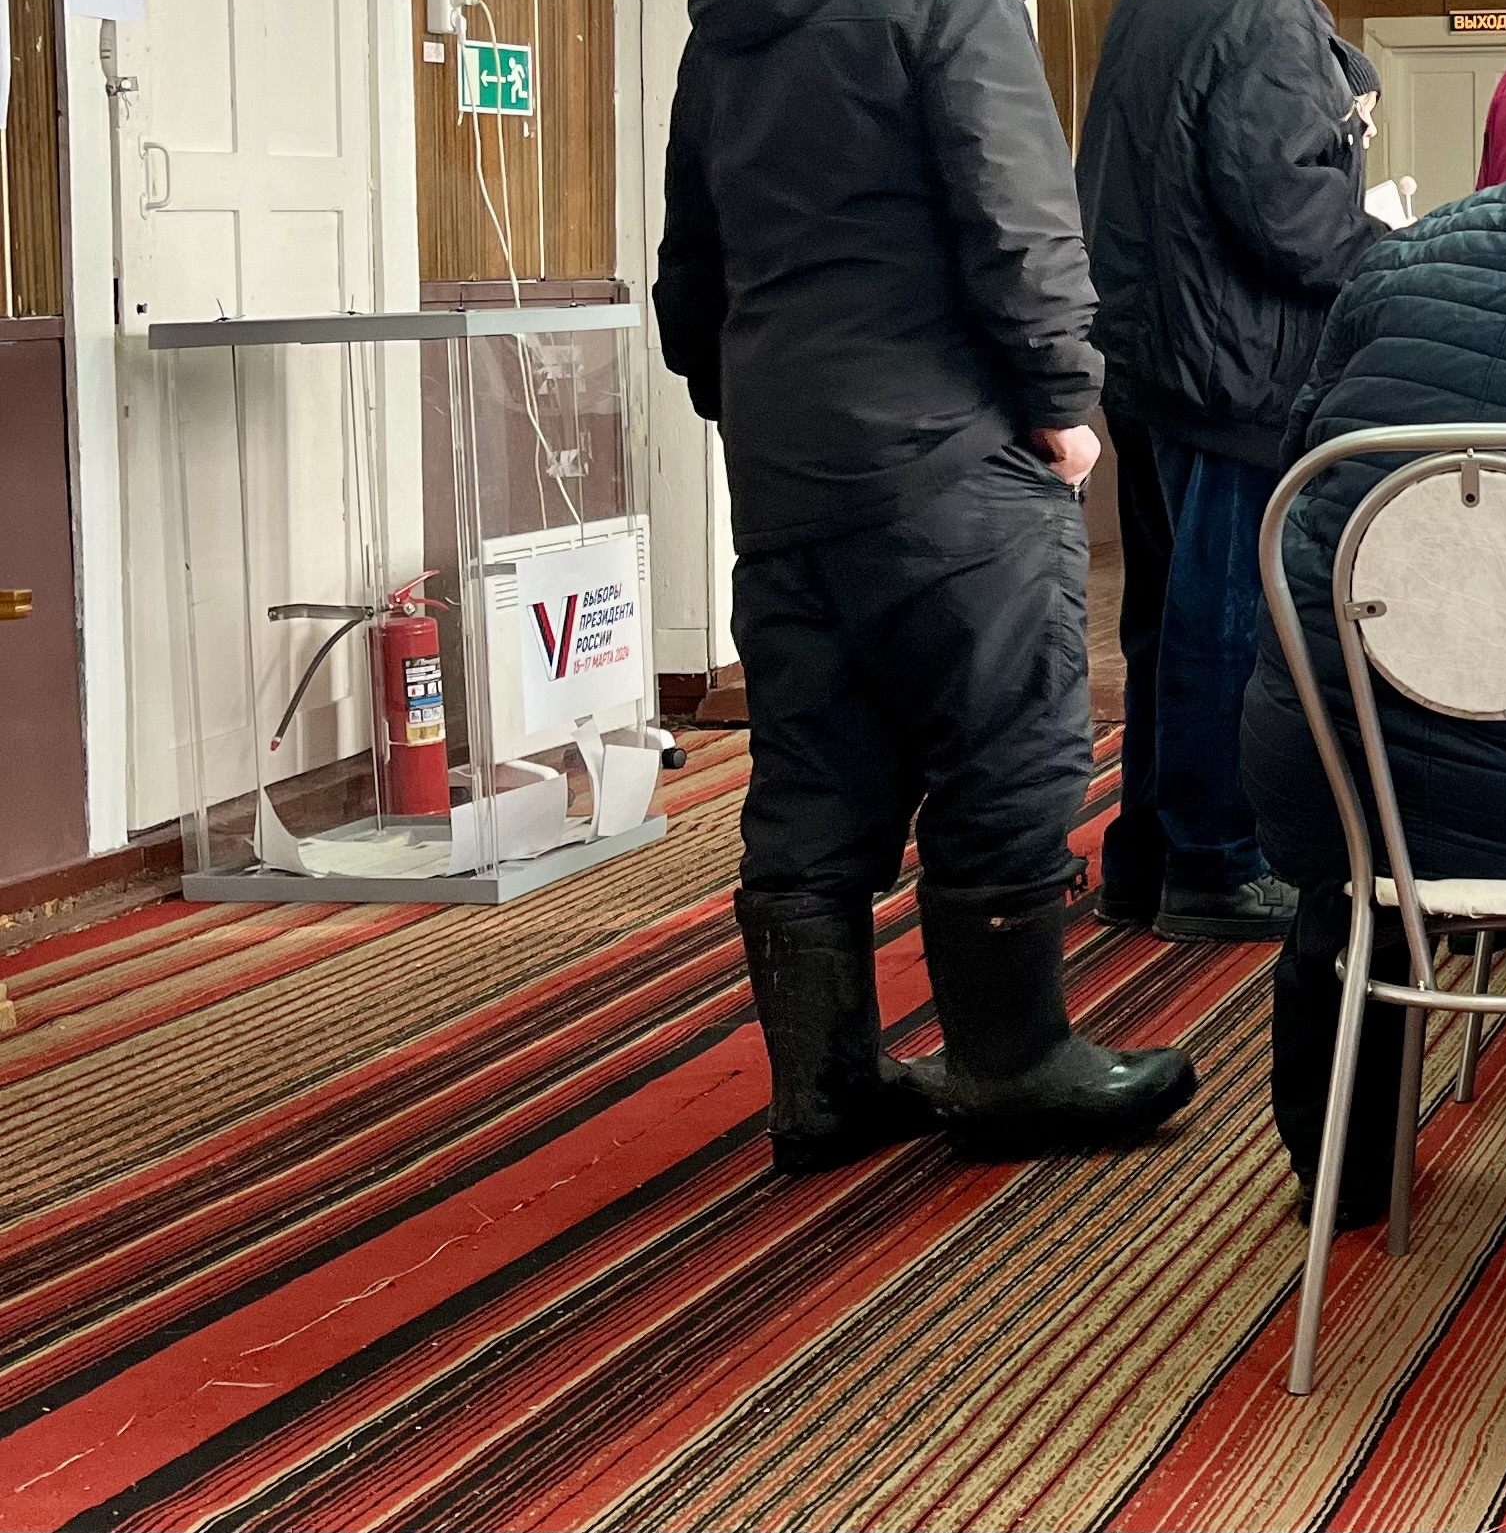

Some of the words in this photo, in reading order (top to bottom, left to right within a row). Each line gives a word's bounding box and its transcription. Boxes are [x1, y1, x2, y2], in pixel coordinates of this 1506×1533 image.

[582, 582, 623, 608] ВЫБОРЫ
[579, 601, 634, 631] ПРЕЗИДЕНТА
[575, 629, 612, 654] РОССИИ
[592, 650, 613, 669] МАРТА
[614, 645, 629, 663] 2024
